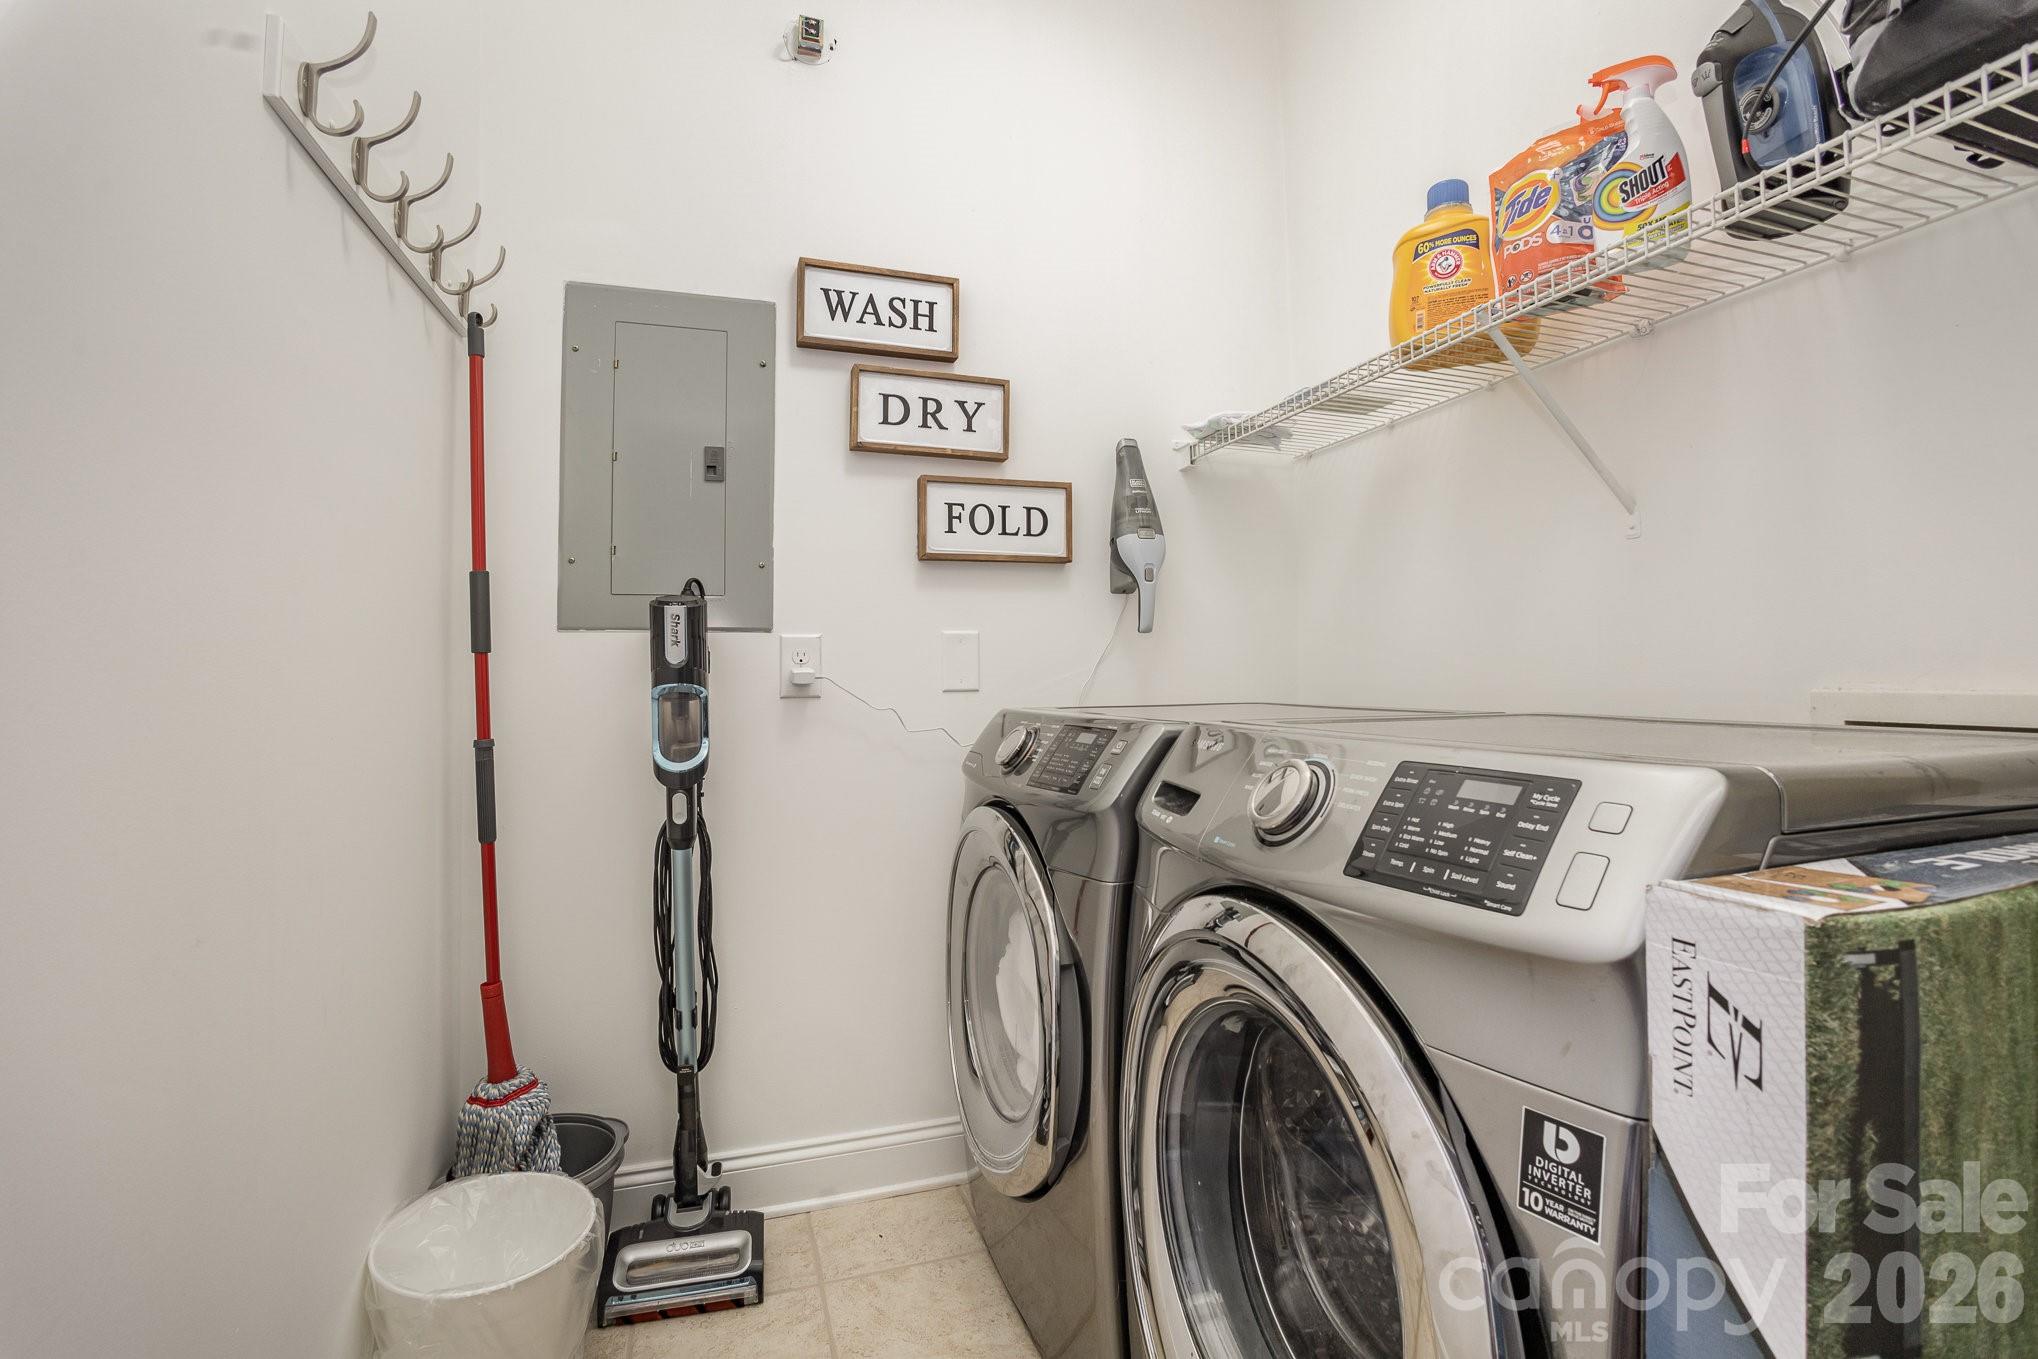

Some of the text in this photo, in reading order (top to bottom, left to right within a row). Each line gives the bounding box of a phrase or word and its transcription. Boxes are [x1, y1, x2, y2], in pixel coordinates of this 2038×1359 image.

[1619, 155, 1666, 203] SHOUT
[1634, 181, 1669, 205] Triple Acting
[1501, 182, 1553, 235] Tide
[1417, 234, 1477, 254] 60% MORE OUNCES
[1504, 232, 1543, 260] PODS
[1424, 285, 1452, 293] NATURALLY
[820, 287, 938, 333] WASH
[878, 392, 986, 433] DRY
[944, 502, 1049, 538] FOLD
[671, 613, 681, 648] Shark
[1533, 793, 1560, 802] My Cycle
[1517, 821, 1550, 832] Delay End
[1469, 846, 1489, 856] Normal
[1473, 837, 1491, 847] Heavy
[1503, 848, 1517, 858] Self
[1422, 865, 1435, 874] Spin
[1465, 855, 1480, 864] Light
[1451, 872, 1480, 884] Soil Level
[1496, 880, 1516, 891] Sound
[1671, 937, 1697, 1097] EASTPOINT
[1528, 1164, 1591, 1200] INVERTER
[1535, 1155, 1585, 1185] DIGITAL
[1522, 1187, 1565, 1212] 10 YEAR
[1528, 1176, 1591, 1206] TECHNOLOGY
[1545, 1206, 1596, 1236] WARRANTY
